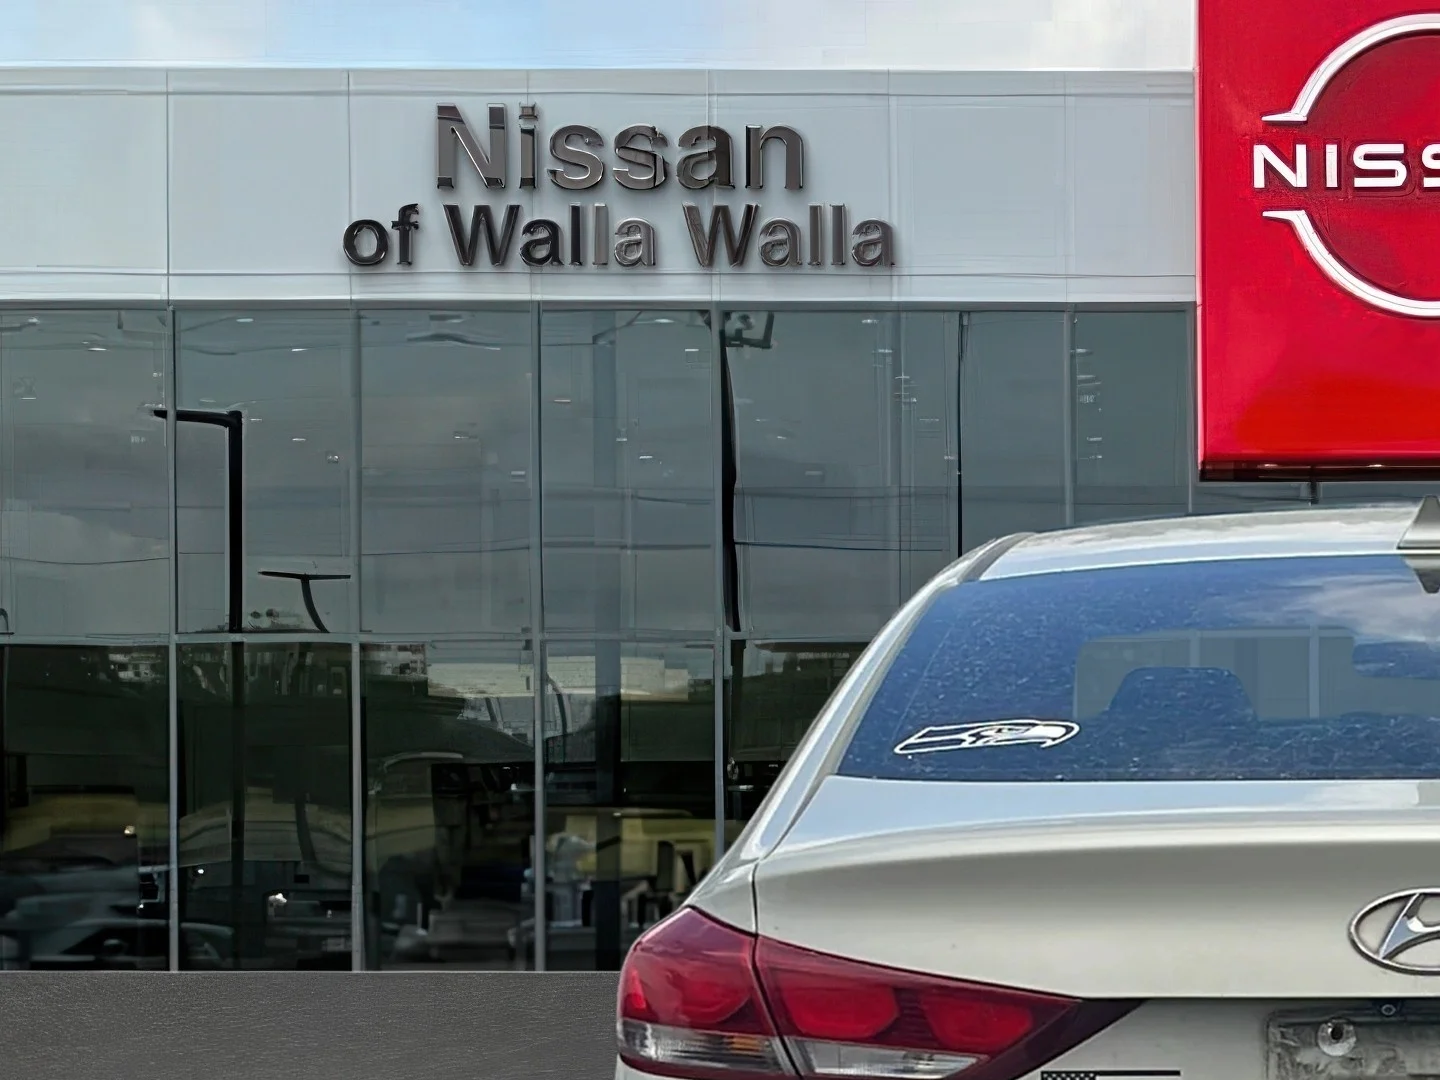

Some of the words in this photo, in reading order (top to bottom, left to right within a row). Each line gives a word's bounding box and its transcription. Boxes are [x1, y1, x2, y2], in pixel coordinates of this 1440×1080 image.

[435, 102, 806, 190] Nissan
[342, 203, 421, 266] of
[443, 202, 656, 266] Walla
[682, 202, 896, 267] Walla
